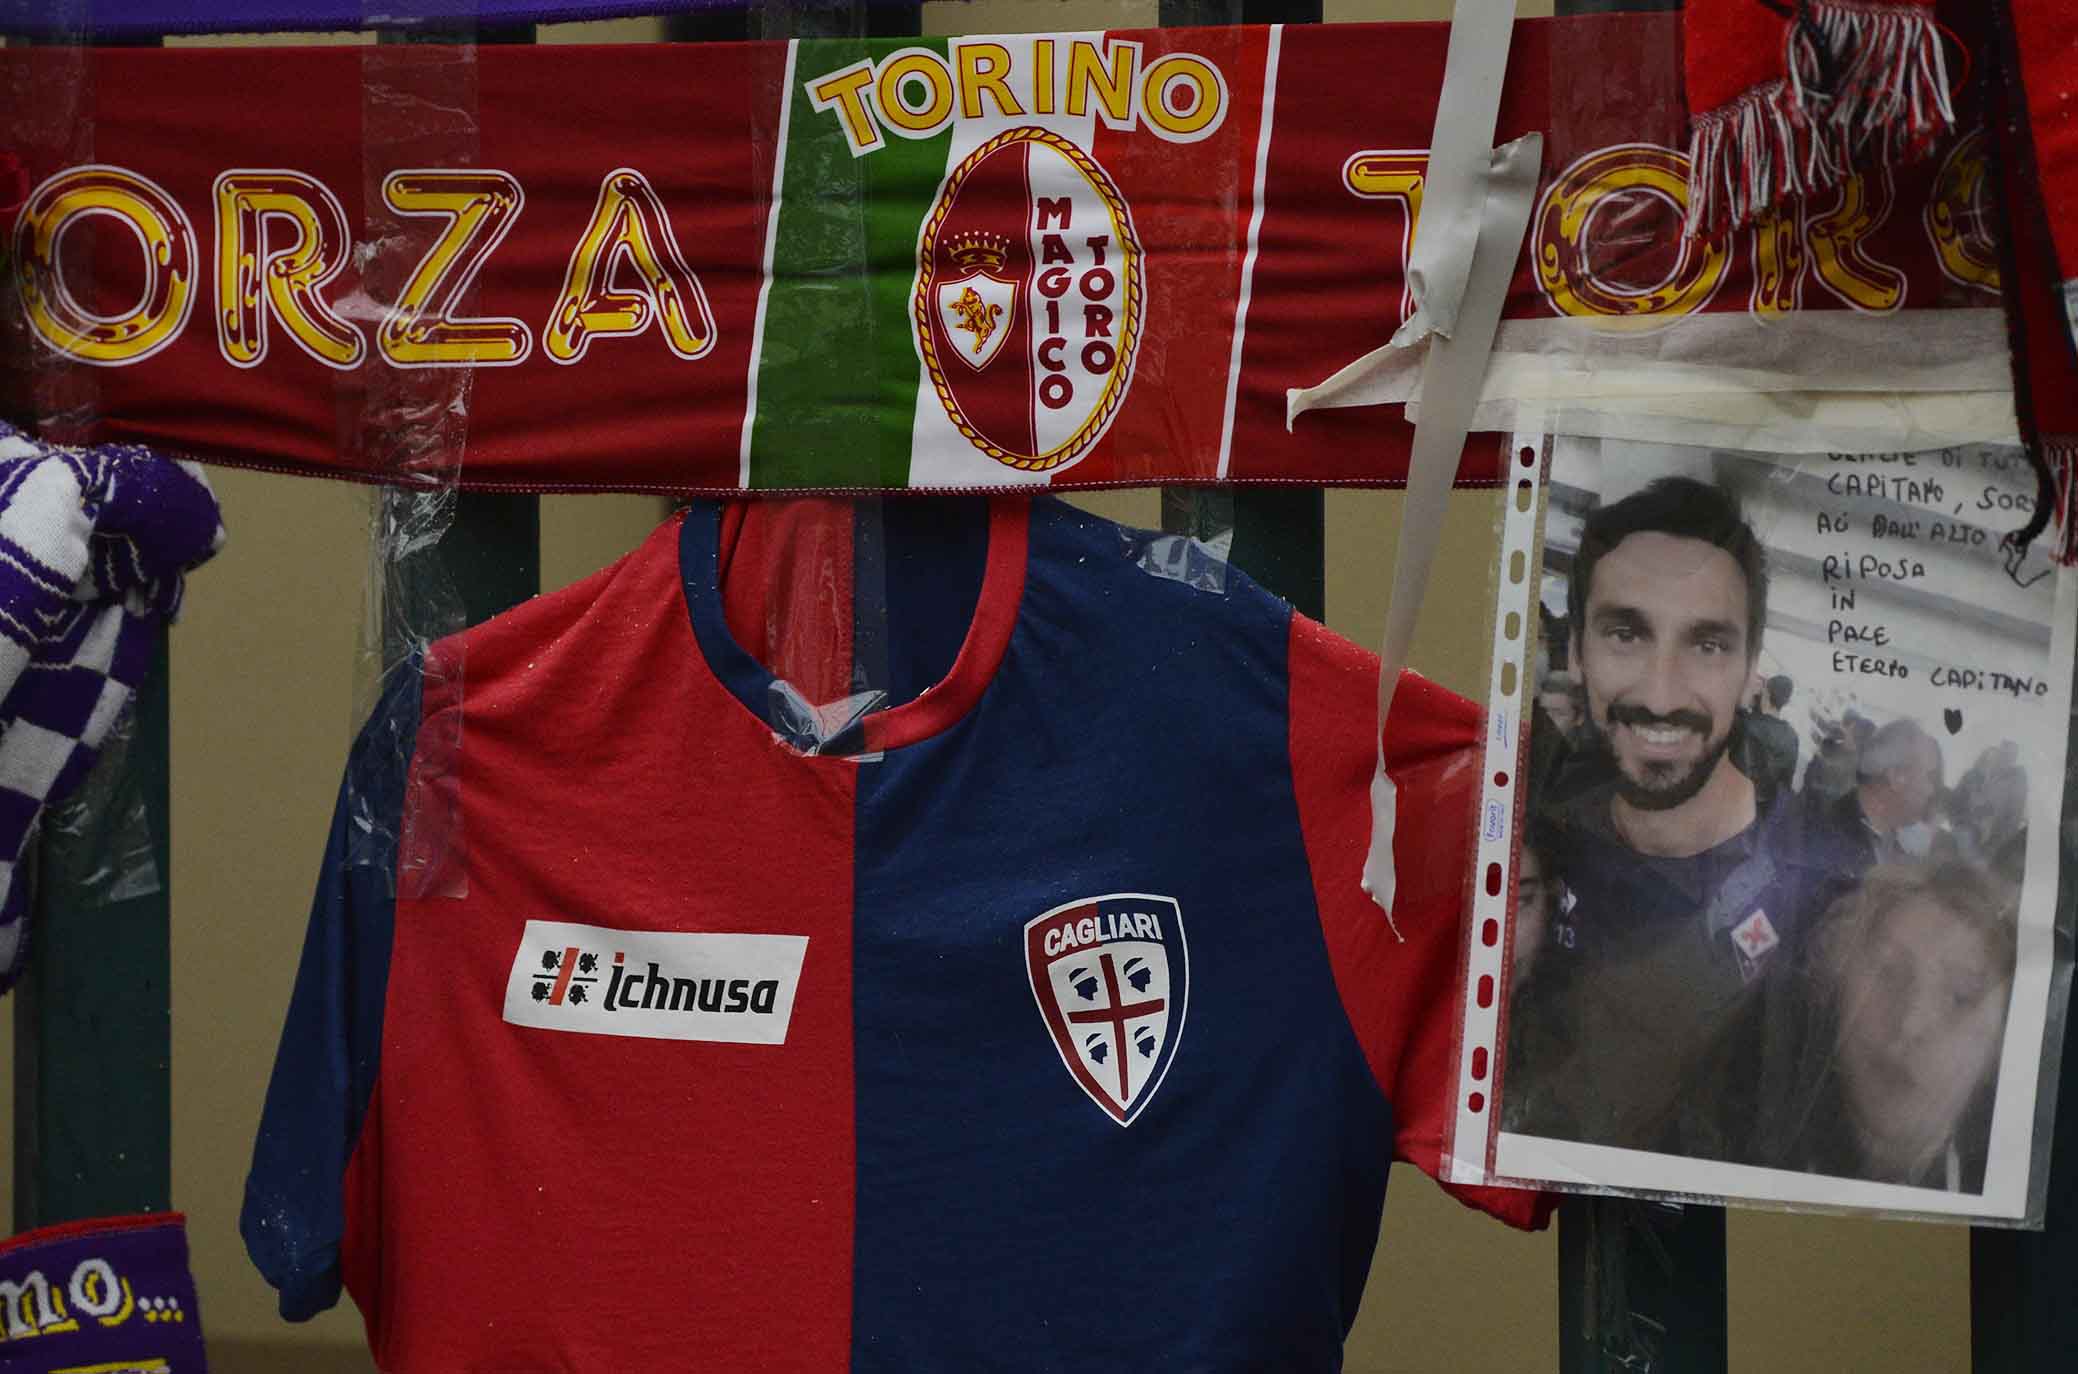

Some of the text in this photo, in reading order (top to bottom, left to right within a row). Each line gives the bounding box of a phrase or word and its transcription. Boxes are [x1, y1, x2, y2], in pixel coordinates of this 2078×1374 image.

[805, 39, 1228, 158] TORINO
[1035, 197, 1074, 409] MAGICO
[1078, 235, 1117, 375] TORO
[1828, 620, 1890, 647] PACE
[1044, 913, 1164, 956] CAGLIARI
[604, 951, 779, 1014] ichnusa
